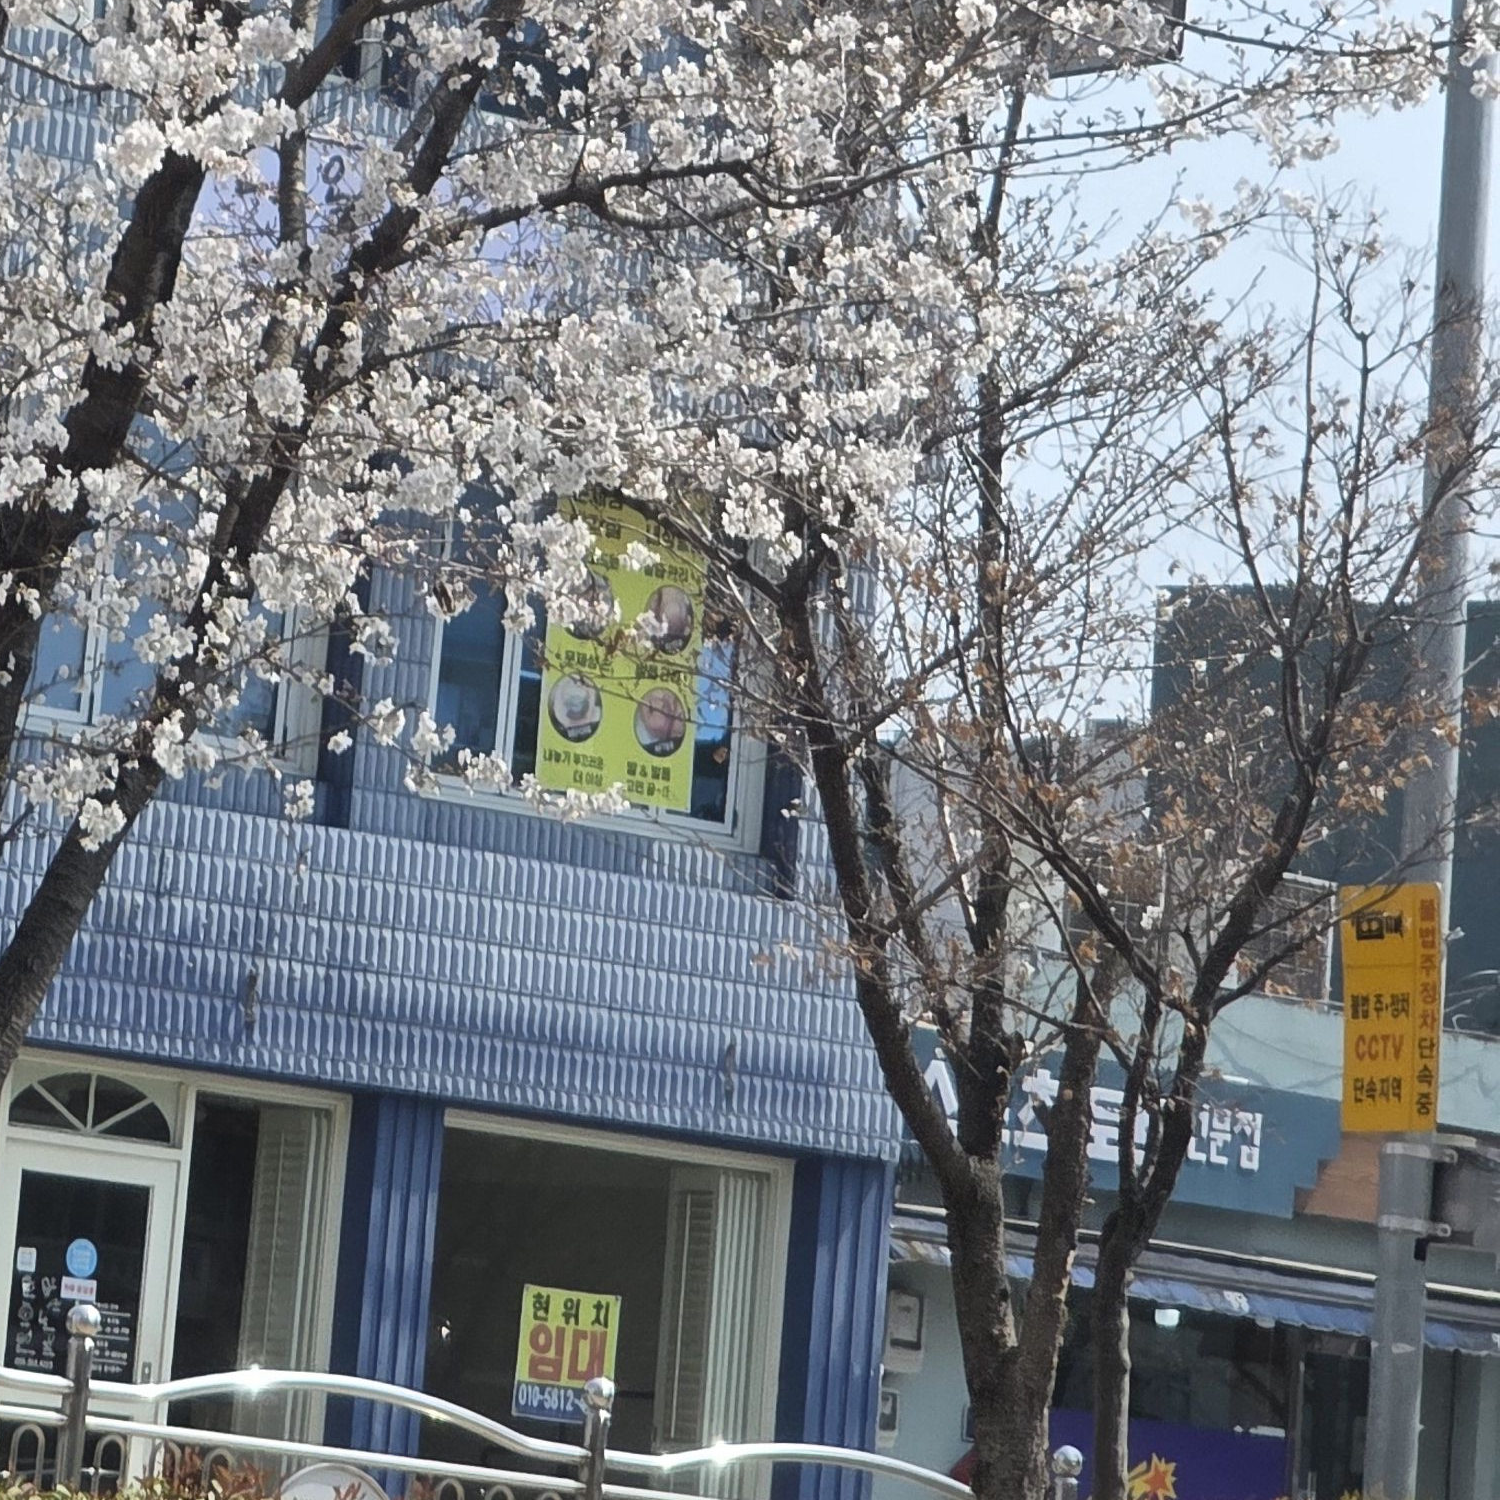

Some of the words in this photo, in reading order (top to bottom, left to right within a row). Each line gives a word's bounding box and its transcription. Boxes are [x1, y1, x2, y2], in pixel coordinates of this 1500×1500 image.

[1350, 993, 1370, 1020] 불법
[1355, 1034, 1404, 1062] CCTV
[1353, 1077, 1403, 1104] 단속지역
[528, 1323, 608, 1382] 임대
[518, 1384, 583, 1412] 010-5812-
